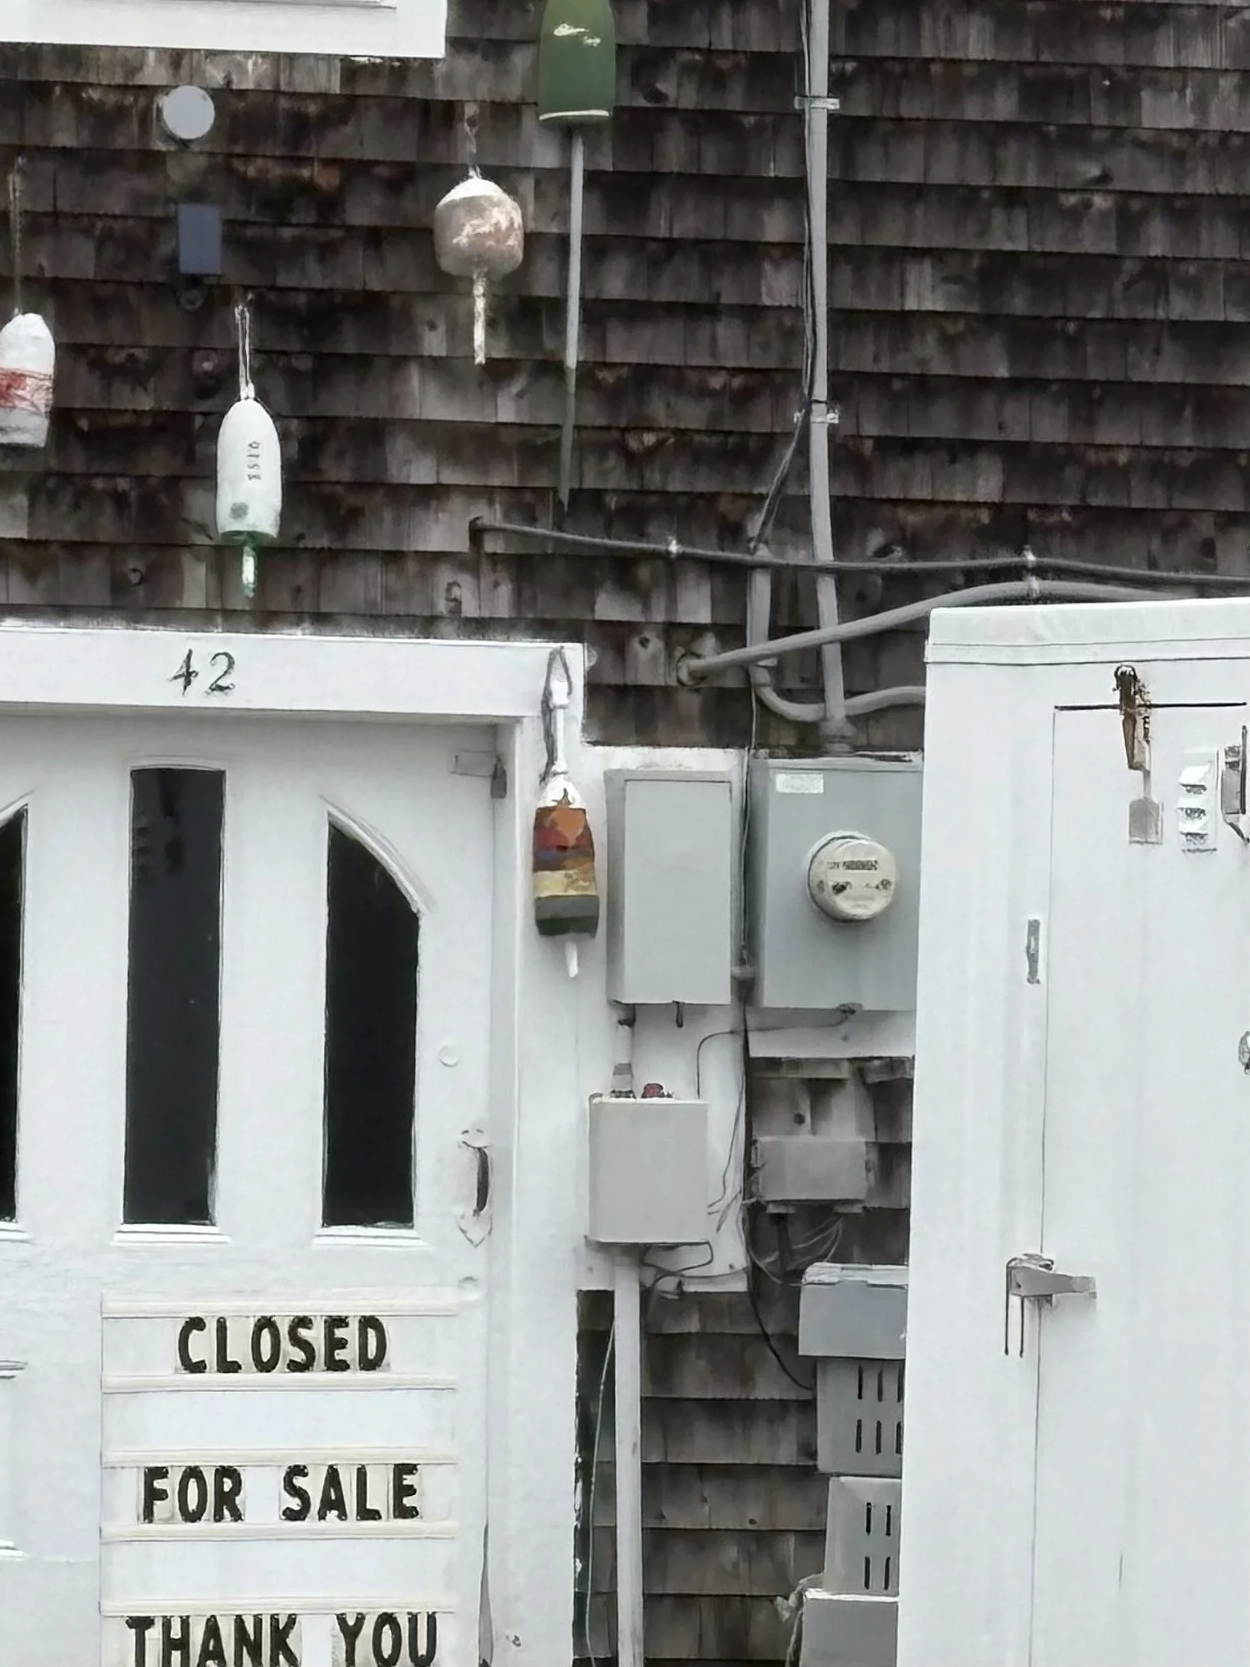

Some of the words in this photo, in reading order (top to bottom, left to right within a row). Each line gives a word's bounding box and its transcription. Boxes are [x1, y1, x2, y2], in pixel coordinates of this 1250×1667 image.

[167, 648, 235, 695] 42
[178, 1316, 387, 1373] CLOSED
[143, 1465, 244, 1524] FOR
[281, 1463, 419, 1522] SALE
[125, 1614, 300, 1667] THANK
[336, 1612, 437, 1667] YOU
